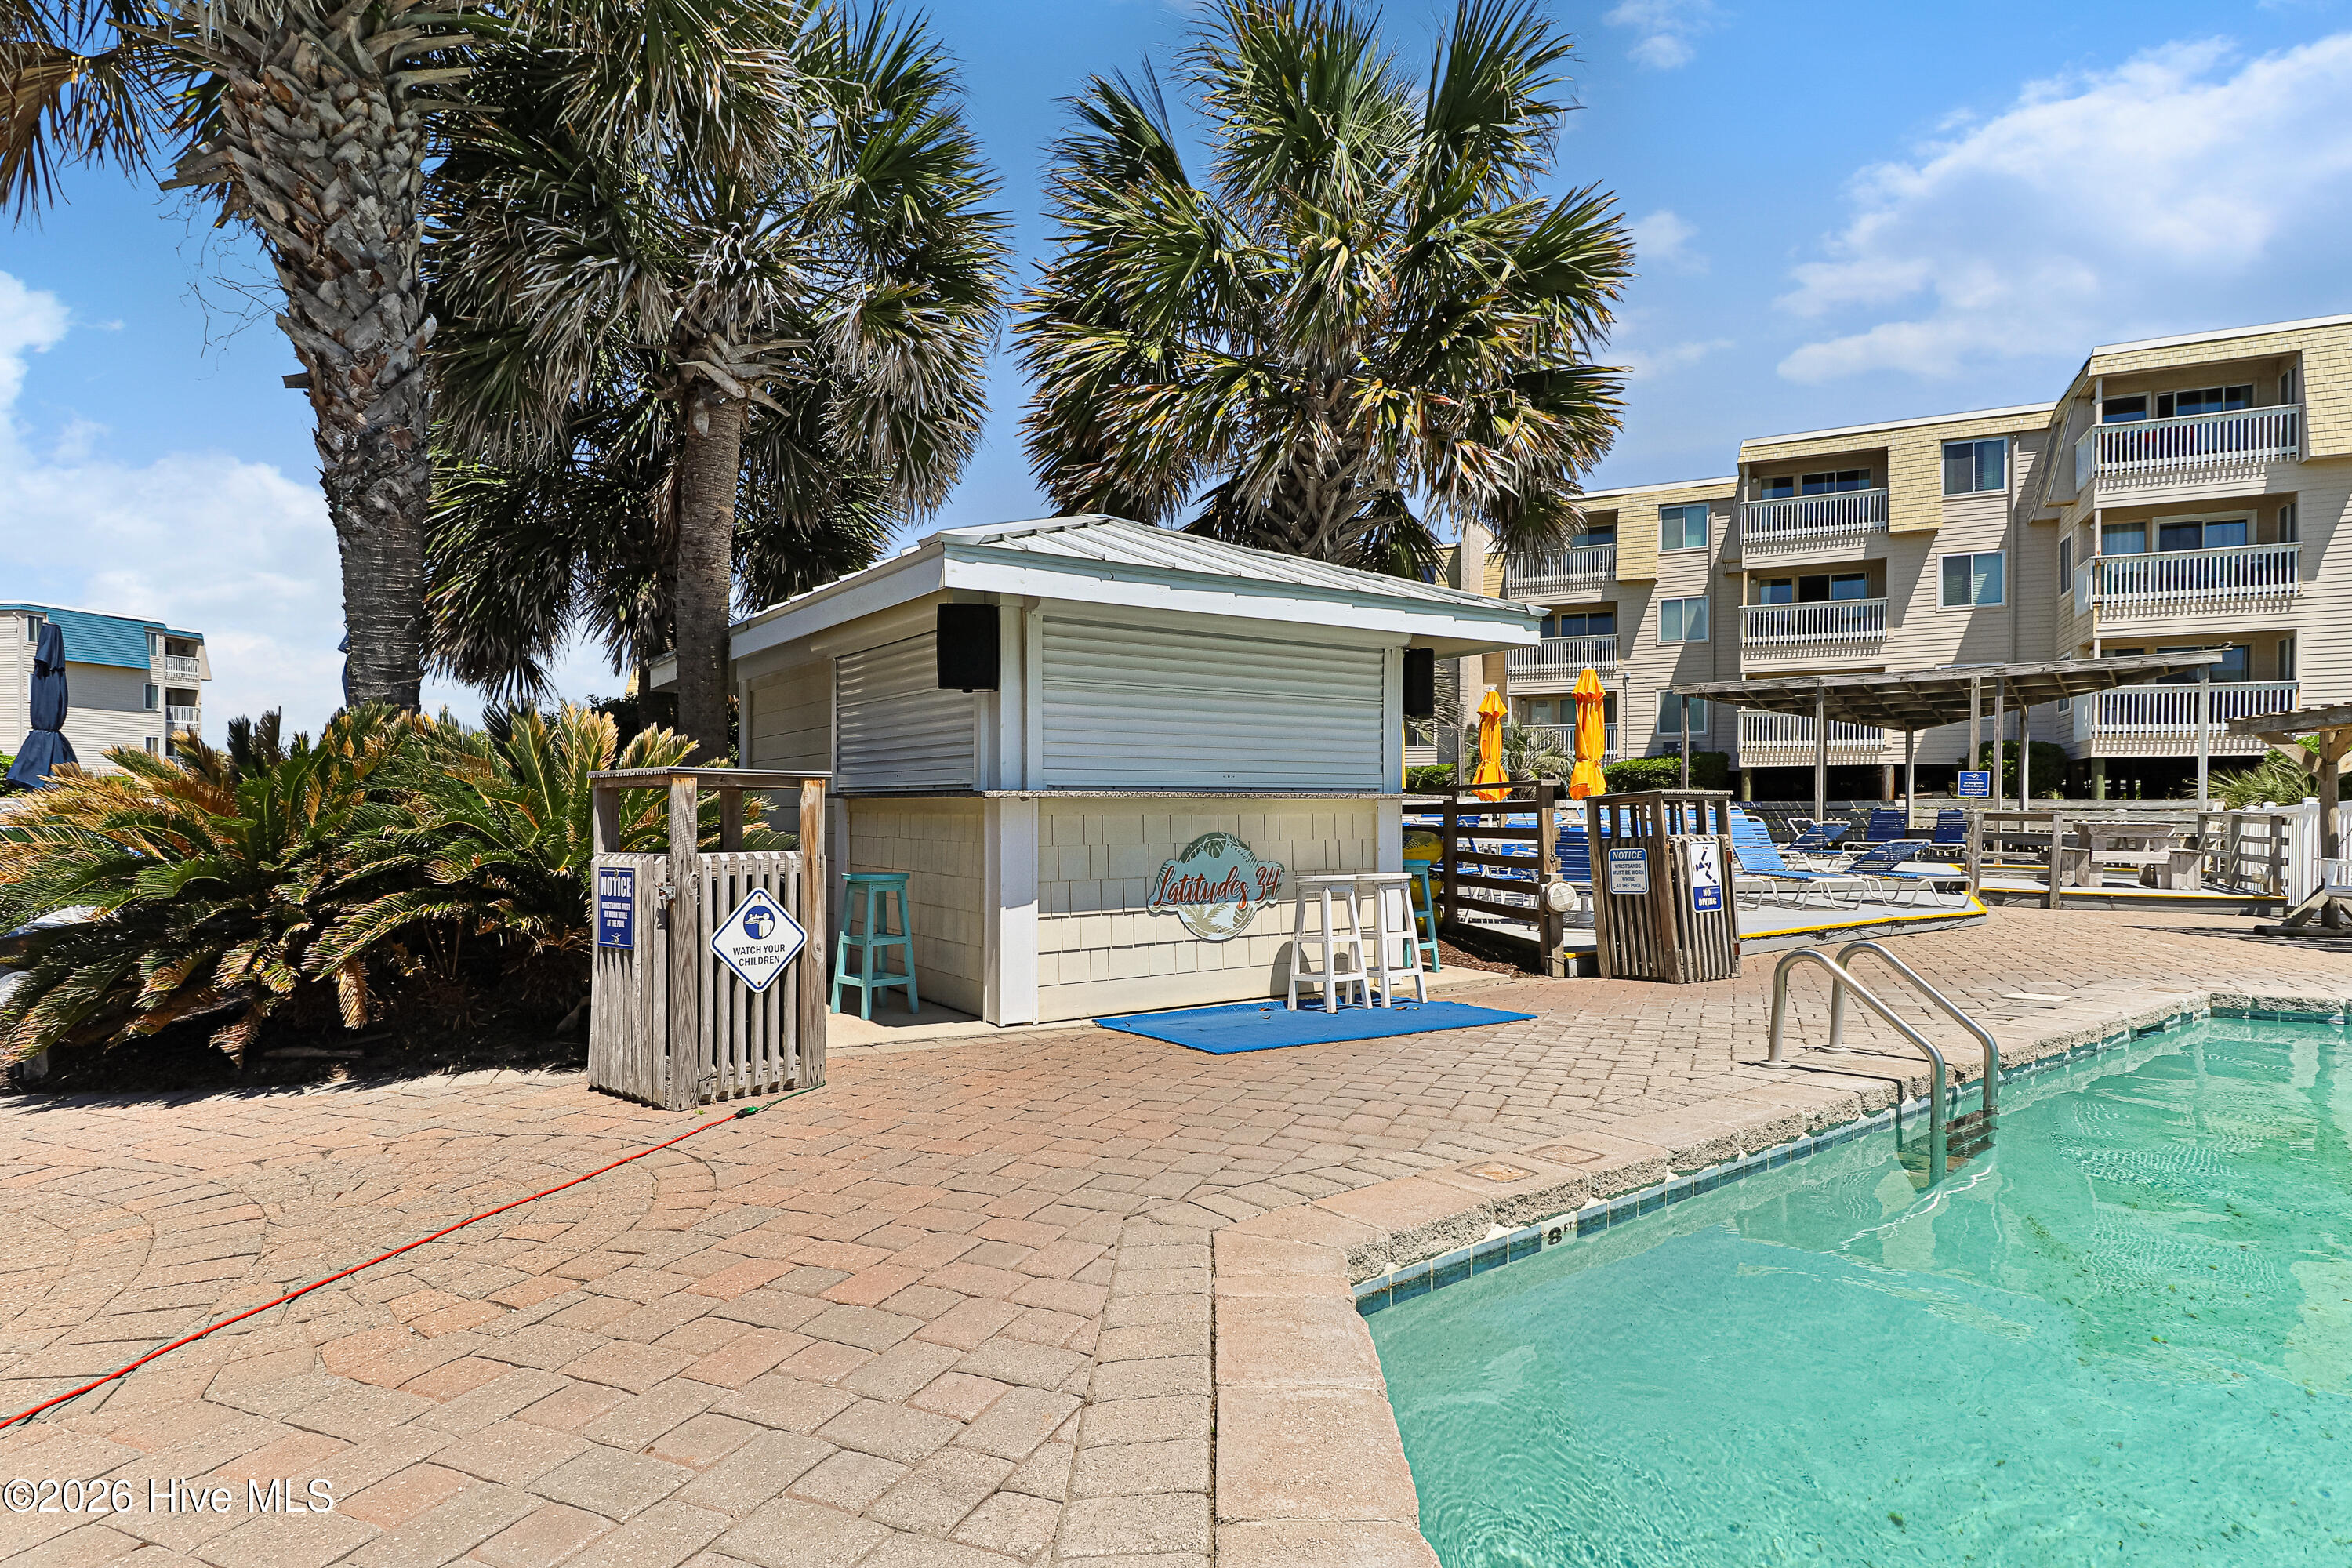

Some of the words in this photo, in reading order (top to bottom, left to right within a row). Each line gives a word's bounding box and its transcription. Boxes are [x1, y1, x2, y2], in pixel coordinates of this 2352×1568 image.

[1612, 851, 1643, 860] NOTICE
[601, 876, 632, 898] NOTICE
[1153, 865, 1249, 909] Latitudes
[1254, 866, 1282, 902] 34
[1702, 888, 1711, 897] NO
[1698, 897, 1717, 906] DIVING
[732, 946, 761, 956] WATCH
[763, 944, 786, 953] YOUR
[739, 955, 780, 967] CHILDREN
[1563, 1221, 1573, 1232] FT
